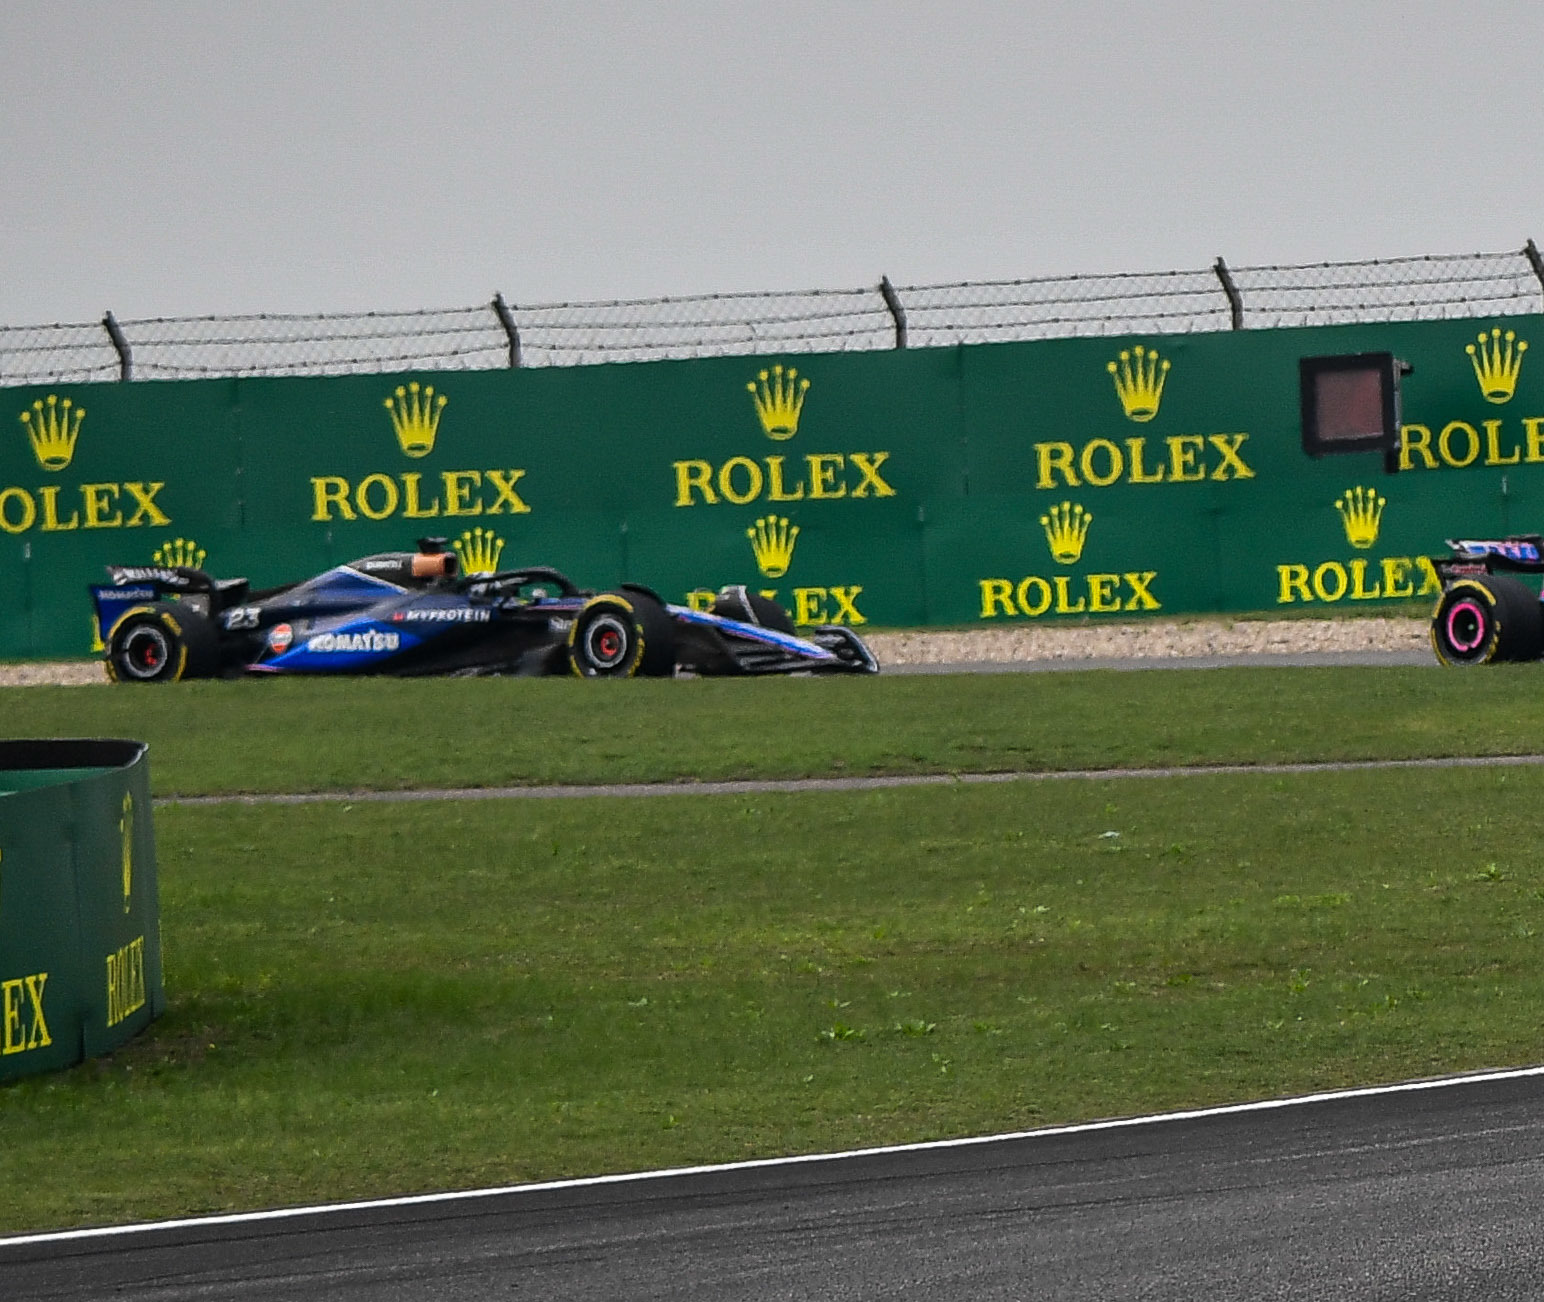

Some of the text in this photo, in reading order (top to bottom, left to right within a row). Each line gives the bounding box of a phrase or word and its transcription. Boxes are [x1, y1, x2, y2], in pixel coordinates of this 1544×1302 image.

[673, 451, 896, 507] ROLEX
[1034, 433, 1255, 489] ROLEX
[0, 482, 171, 534] OLEX
[311, 469, 530, 522] ROLEX
[225, 606, 261, 630] 23
[406, 608, 491, 623] MYPROTEIN
[979, 571, 1161, 618] ROLEX
[307, 631, 400, 653] KOMATSU
